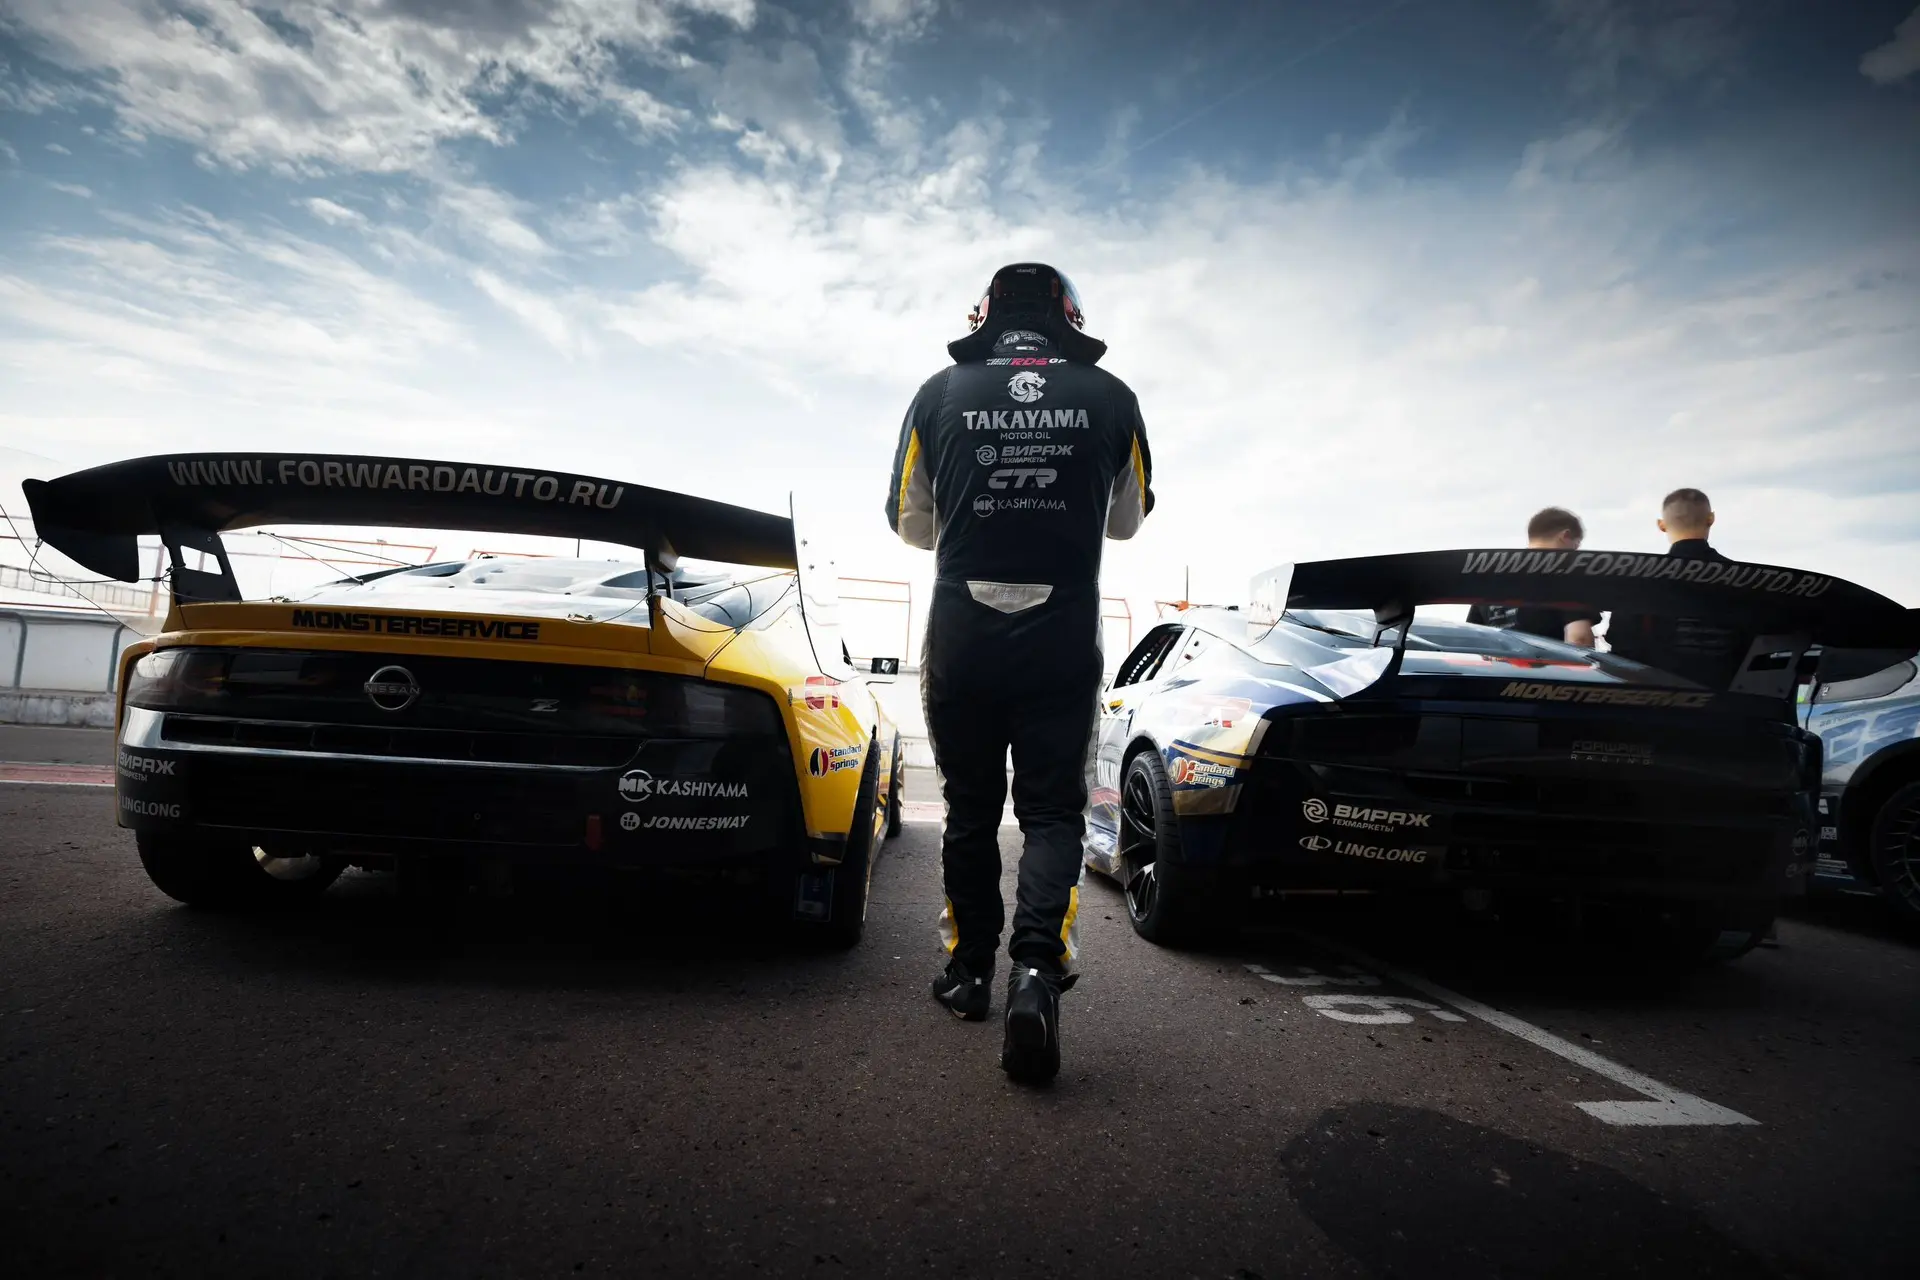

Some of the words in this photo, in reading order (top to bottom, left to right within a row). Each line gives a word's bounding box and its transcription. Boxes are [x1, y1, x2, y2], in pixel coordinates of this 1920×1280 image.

[1010, 356, 1049, 367] RDS
[962, 408, 1090, 431] TAKAYAMA
[1000, 431, 1034, 441] MOTOR
[1034, 431, 1052, 440] OIL
[1001, 444, 1076, 457] ВИРАЖ
[167, 458, 625, 510] WWW.FORWARDAUTO.RU
[987, 467, 1058, 490] CTR
[997, 497, 1067, 512] KASHIYAMA
[1460, 550, 1833, 599] WWW.FORWARDAUTO.RU
[292, 609, 540, 640] MONSTERSERVICE
[364, 682, 421, 695] NISSAN
[1499, 681, 1716, 708] MONSTERSERVICE
[828, 743, 862, 759] Standard
[829, 757, 860, 773] Springs
[655, 779, 749, 798] KASHIYAMA
[121, 795, 181, 818] LINGLONG
[1333, 803, 1433, 828] ВИРАЖ
[643, 814, 751, 831] JONNESWAY
[1331, 817, 1395, 833] ТЕХМАРКЕТЫ
[1333, 840, 1428, 864] LINGLONG
